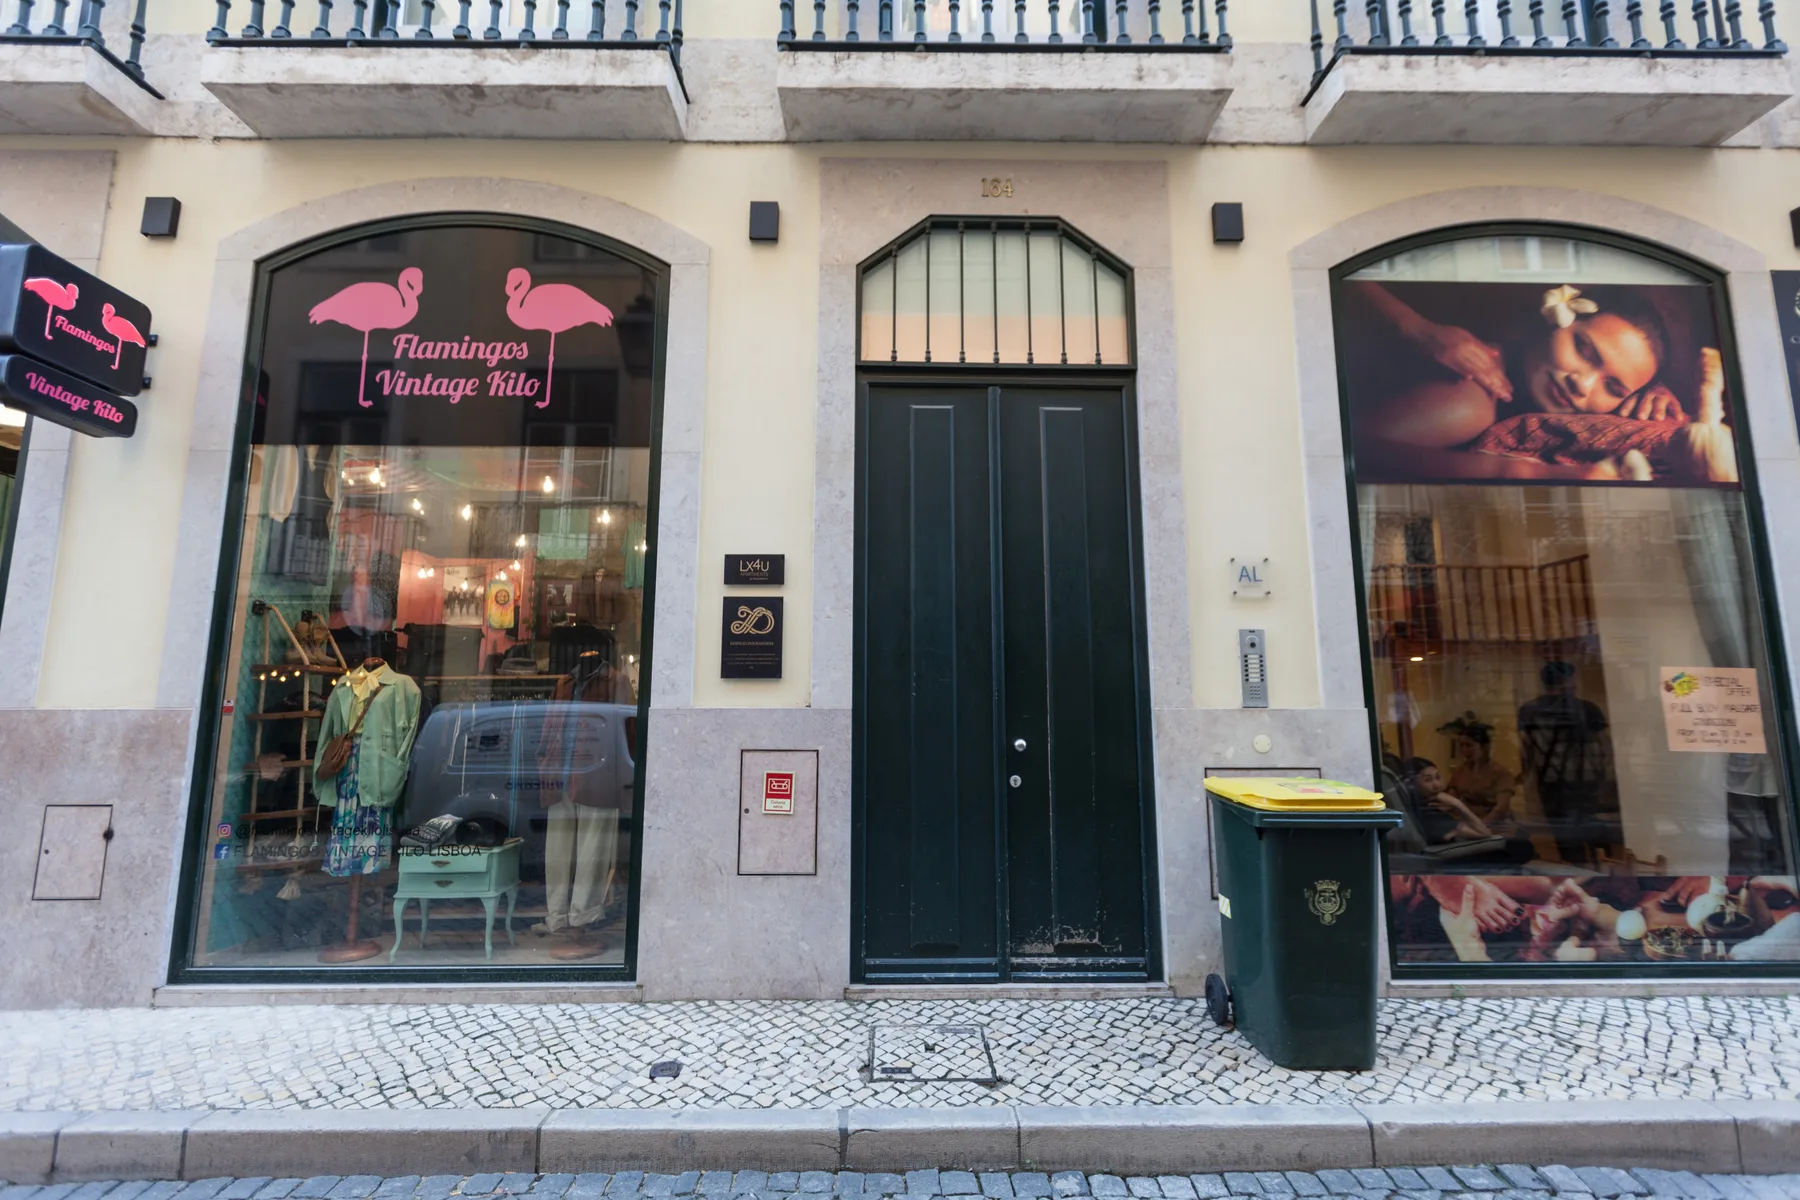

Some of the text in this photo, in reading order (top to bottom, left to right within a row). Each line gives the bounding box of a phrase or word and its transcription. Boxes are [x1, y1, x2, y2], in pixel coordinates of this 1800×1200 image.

[981, 177, 1015, 198] 164
[55, 315, 115, 354] Flamingos
[392, 333, 529, 368] Flamingos
[25, 372, 124, 423] Vintage Kilo
[375, 369, 541, 404] Vintage Kilo
[739, 559, 770, 572] LX4U
[1238, 565, 1264, 583] AL
[233, 845, 320, 858] FLAMINGOS
[324, 845, 388, 858] VINTAGE
[430, 845, 482, 857] LISBOA
